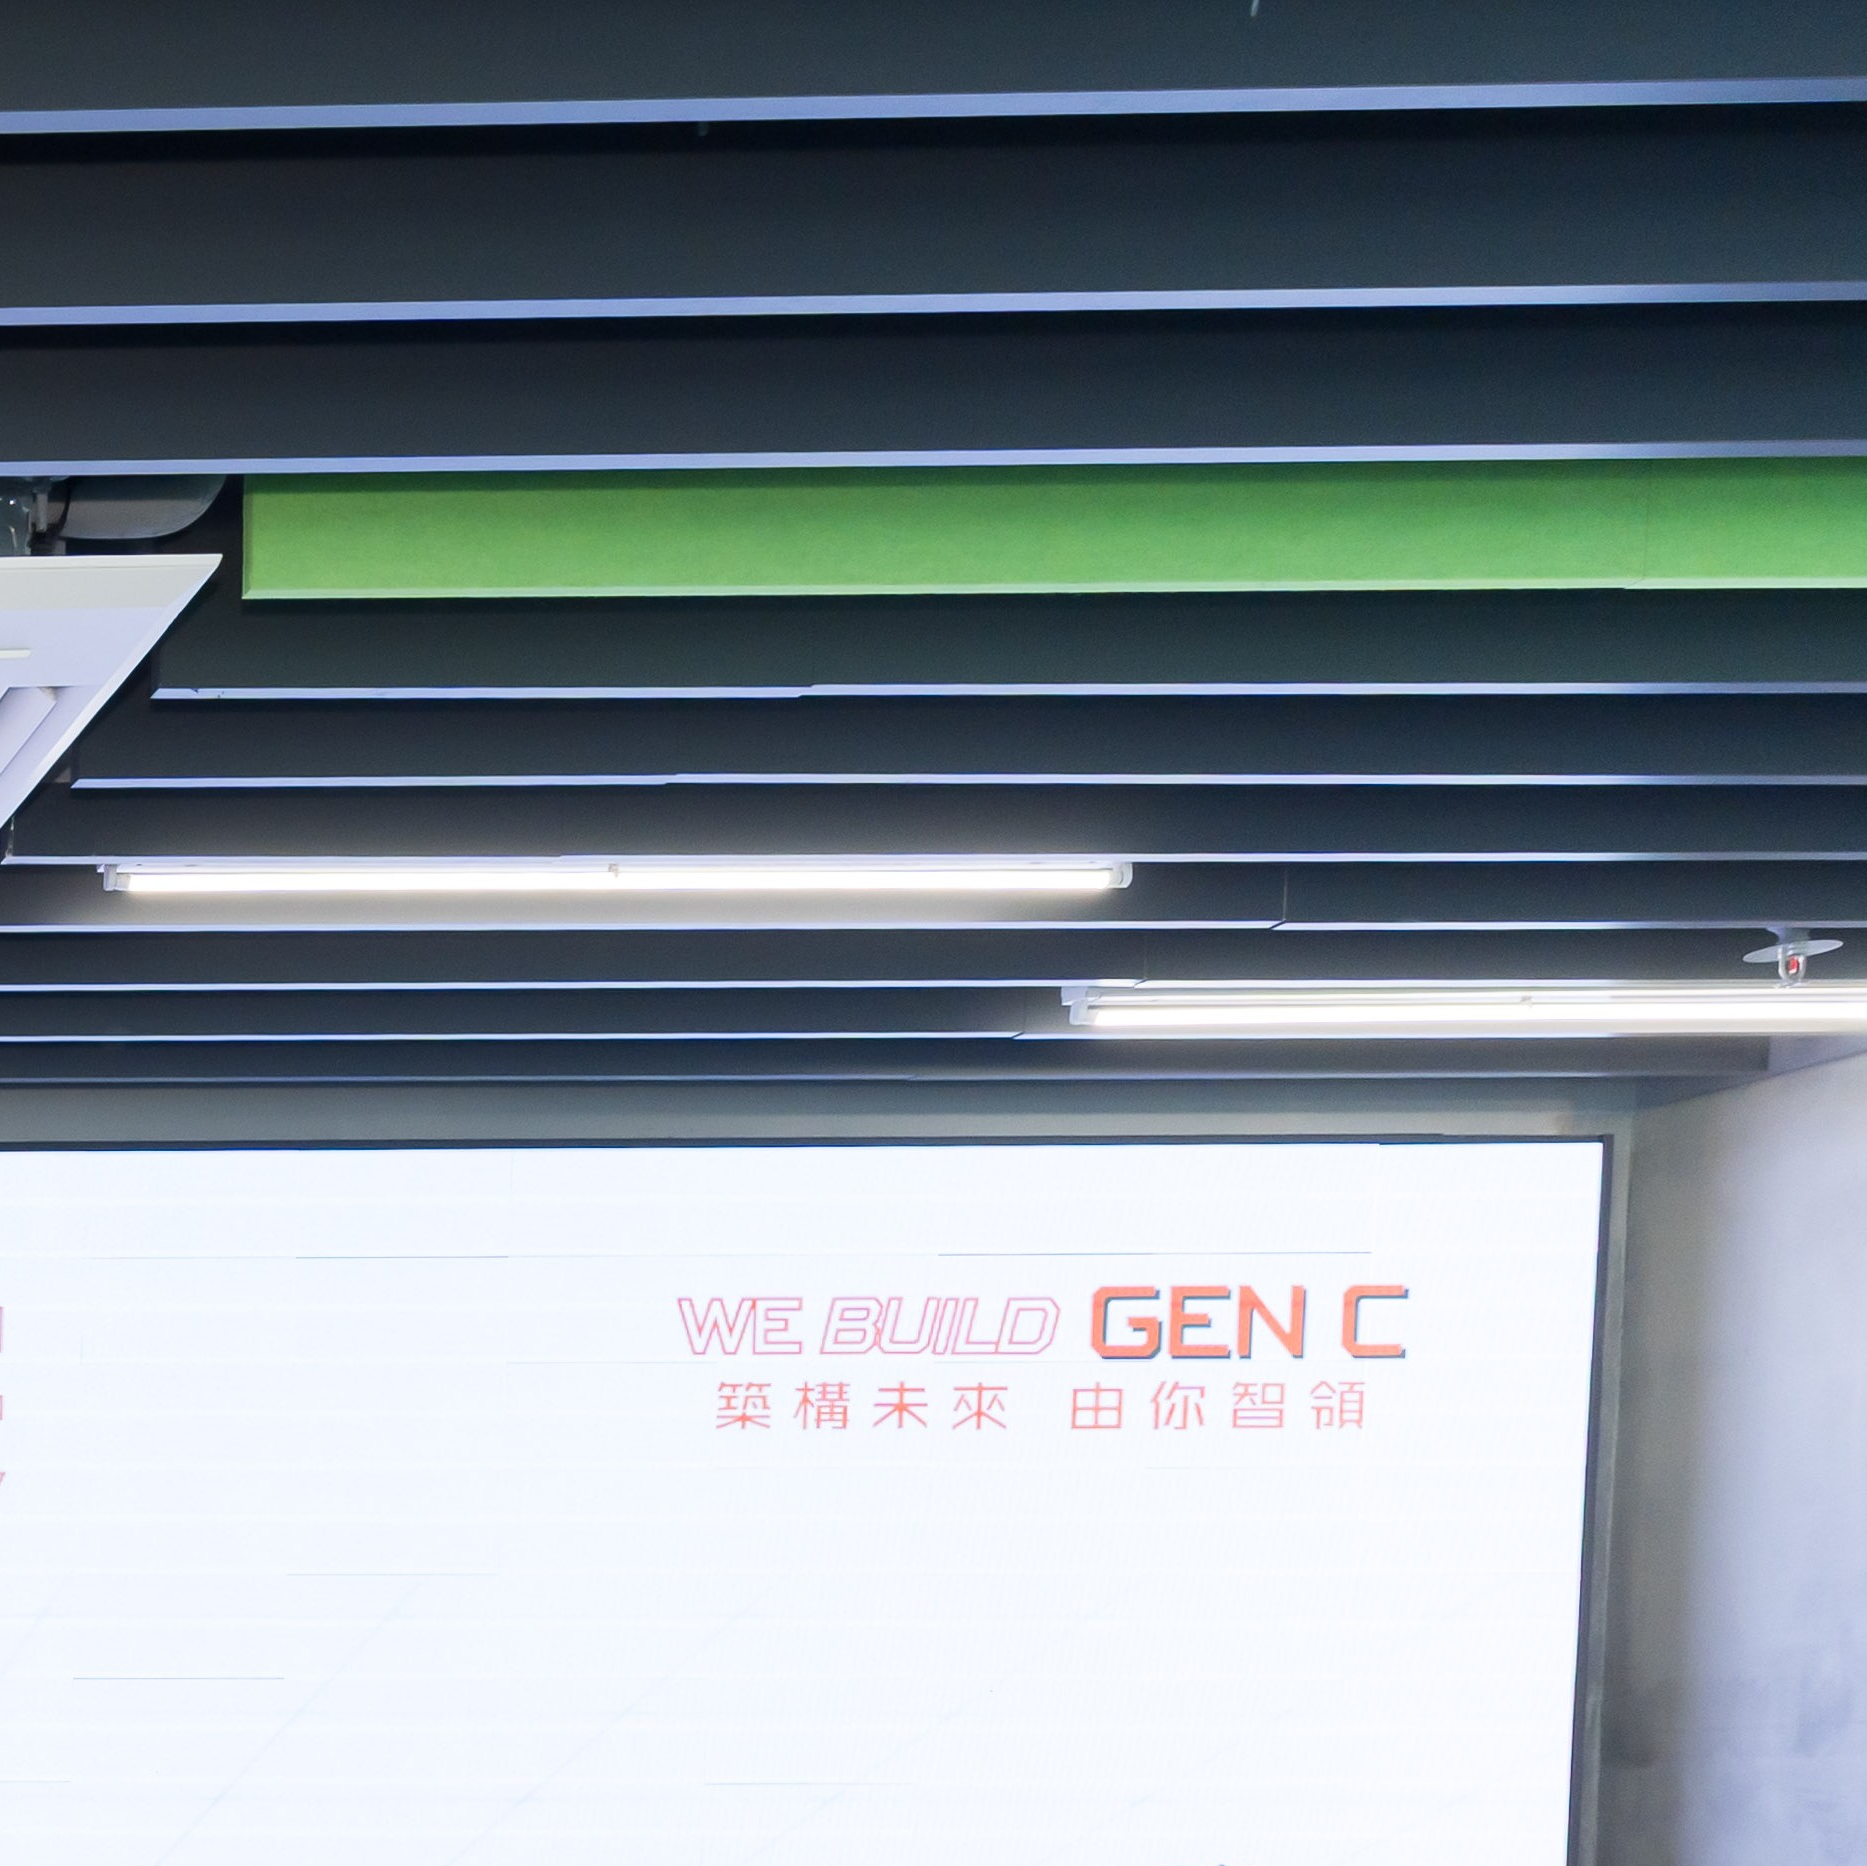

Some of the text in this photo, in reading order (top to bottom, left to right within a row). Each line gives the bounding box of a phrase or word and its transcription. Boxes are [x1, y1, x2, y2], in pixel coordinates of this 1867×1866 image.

[677, 1285, 1409, 1360] WE BUILD GEN C
[715, 1381, 1366, 1430] 築構未來 由你智領
